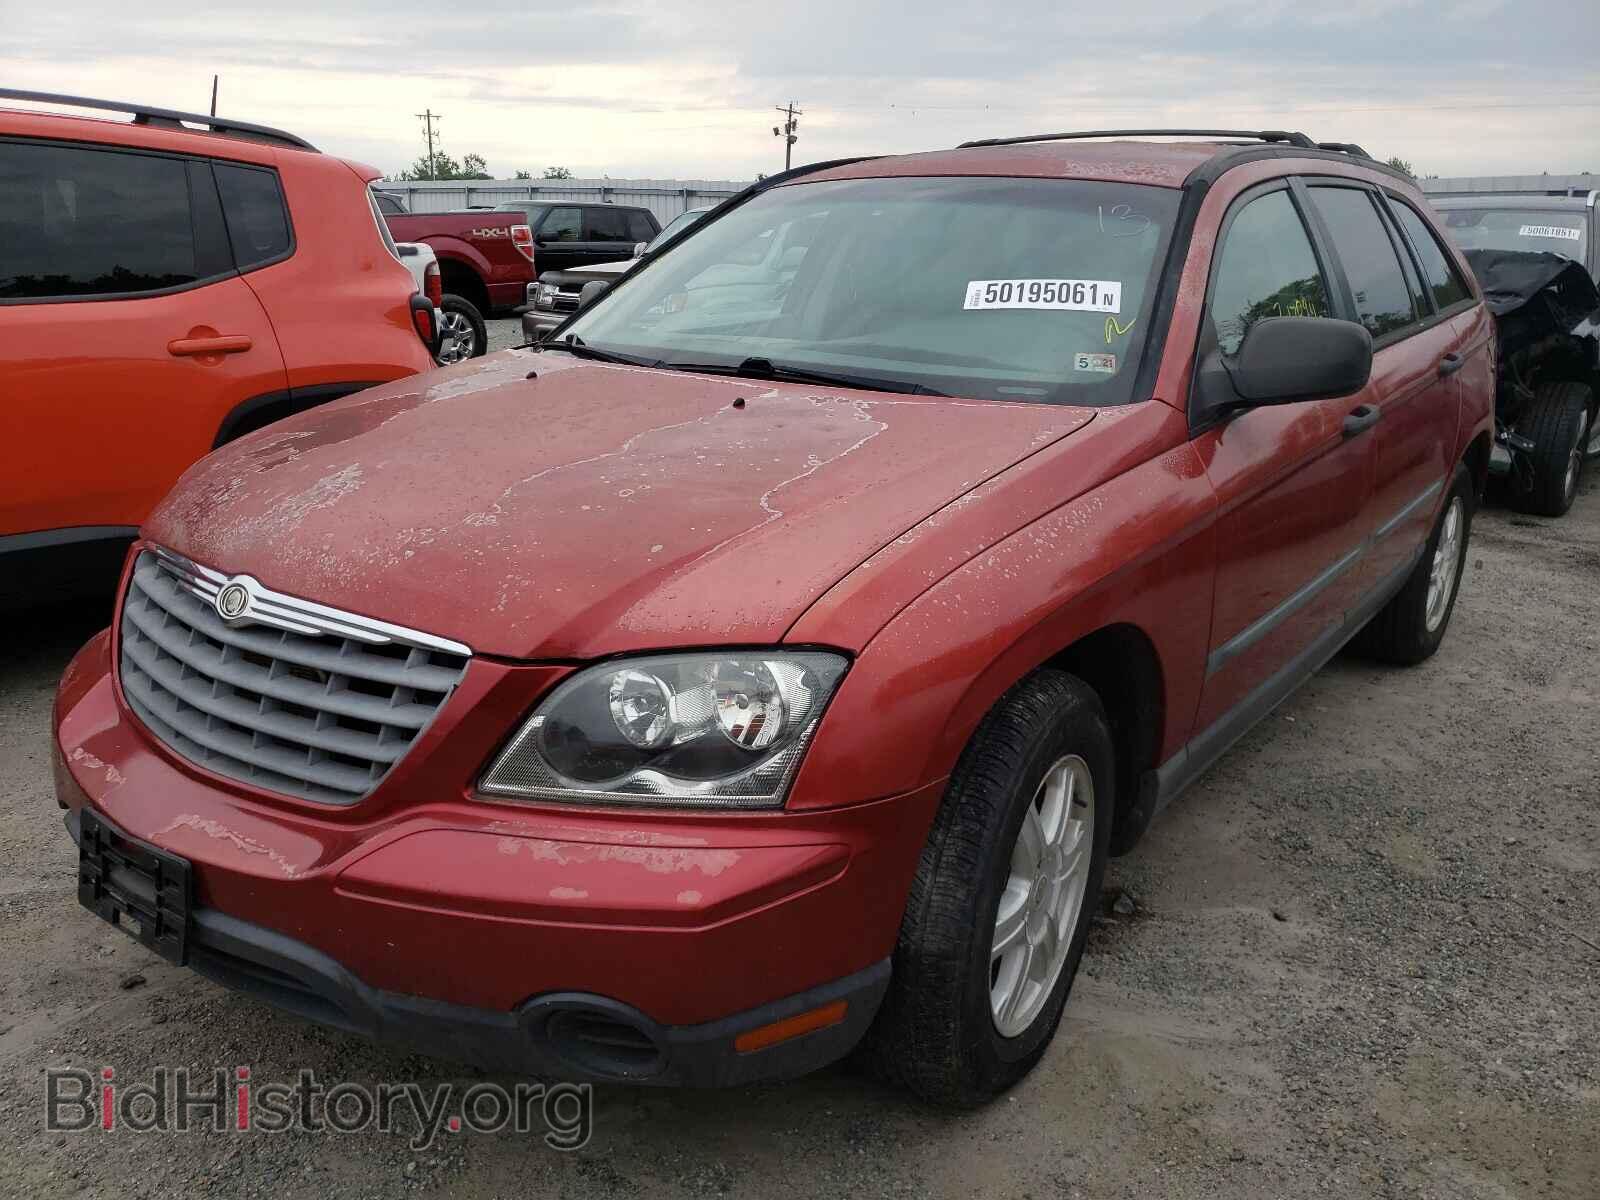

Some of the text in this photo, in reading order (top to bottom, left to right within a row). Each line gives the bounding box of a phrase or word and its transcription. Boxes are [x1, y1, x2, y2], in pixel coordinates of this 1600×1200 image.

[1097, 204, 1152, 238] 13
[984, 281, 1099, 305] 50195061
[1103, 293, 1114, 306] N
[1079, 357, 1089, 369] 5
